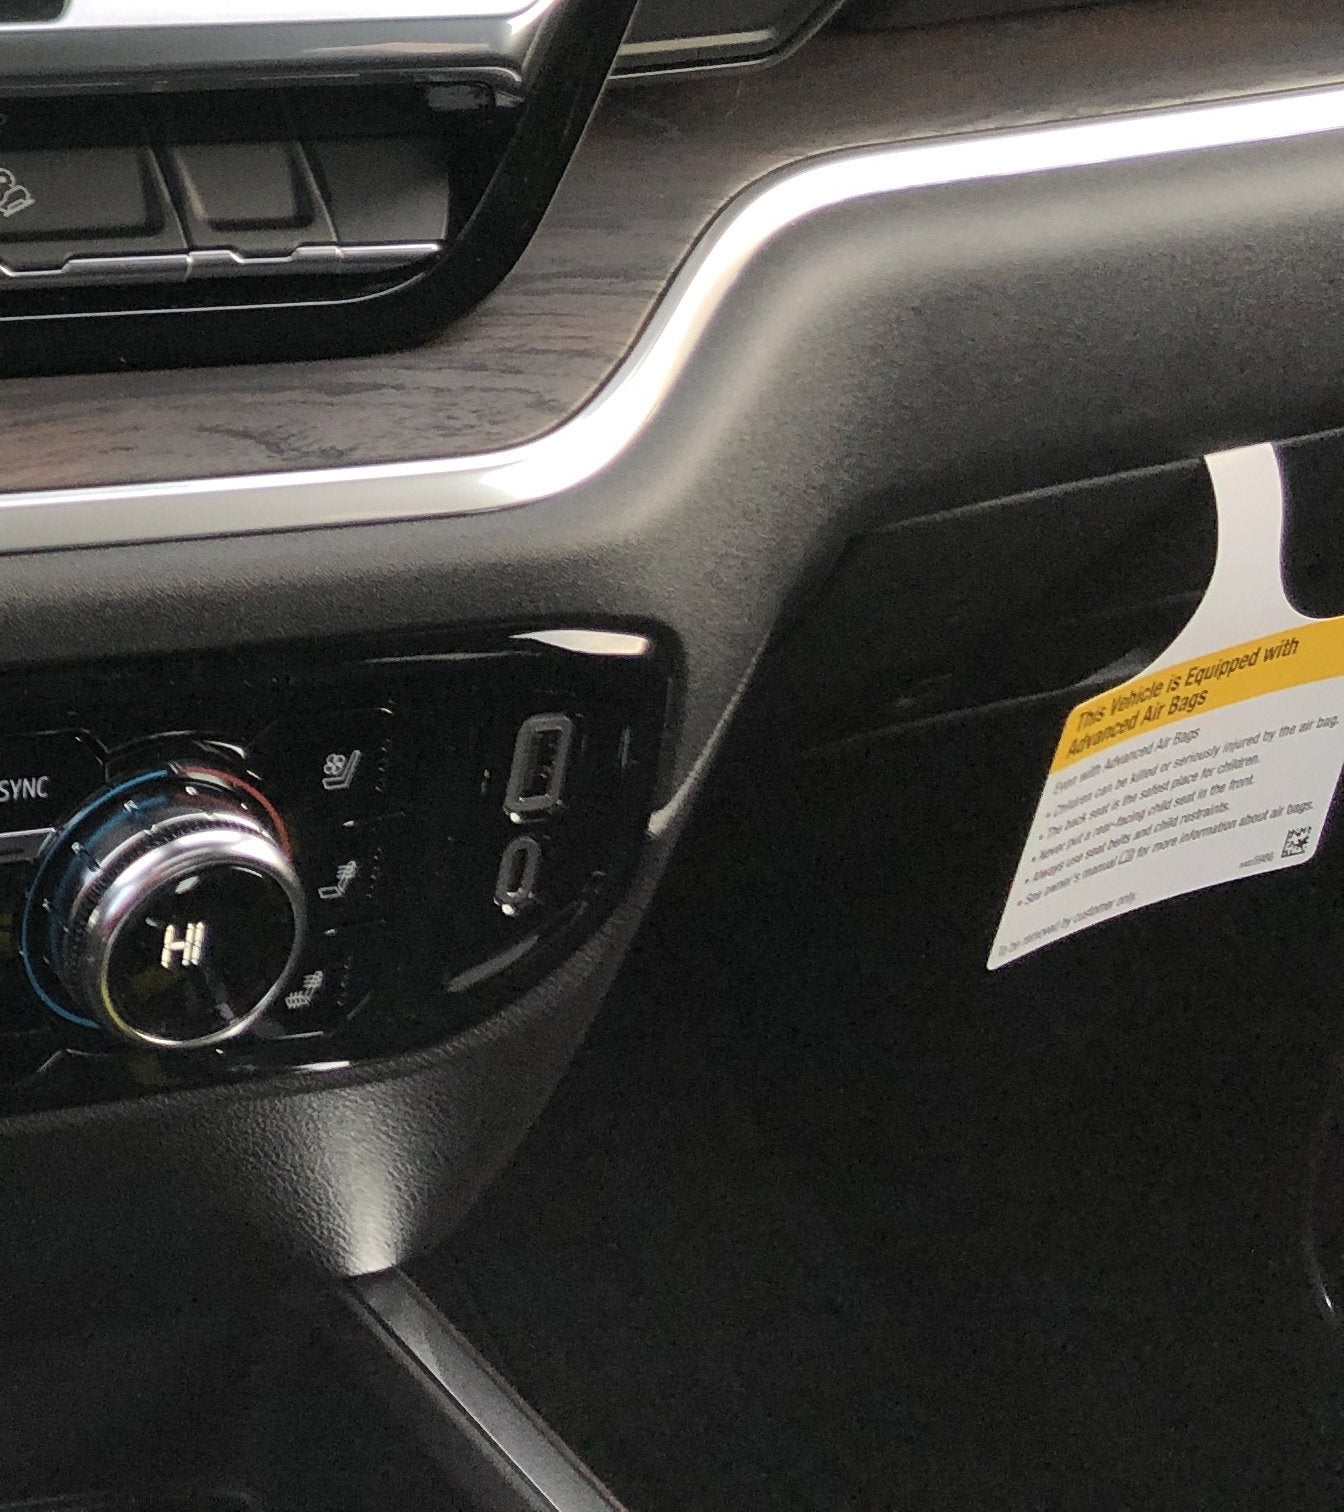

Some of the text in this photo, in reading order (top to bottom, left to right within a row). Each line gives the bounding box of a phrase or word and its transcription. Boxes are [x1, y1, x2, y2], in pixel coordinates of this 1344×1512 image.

[1077, 637, 1300, 732] This Vehicle is Equipped with
[1066, 689, 1209, 758] Advanced Air Bags
[1154, 736, 1172, 752] Air
[1172, 728, 1200, 746] Bags
[1159, 761, 1172, 773] or
[1173, 745, 1221, 769] seriously
[1222, 732, 1261, 754] injured
[1262, 730, 1276, 743] by
[1278, 724, 1297, 738] the
[1298, 720, 1314, 733] air
[1316, 715, 1340, 729] bag.
[1170, 772, 1199, 791] place
[1200, 767, 1216, 780] for
[1216, 754, 1261, 775] children.
[1173, 791, 1196, 808] seat
[1209, 783, 1227, 796] the
[1151, 836, 1179, 853] more
[1179, 818, 1238, 843] information
[1238, 809, 1269, 827] about
[1269, 805, 1285, 819] air
[1286, 800, 1314, 815] bags.
[161, 920, 207, 969] HI
